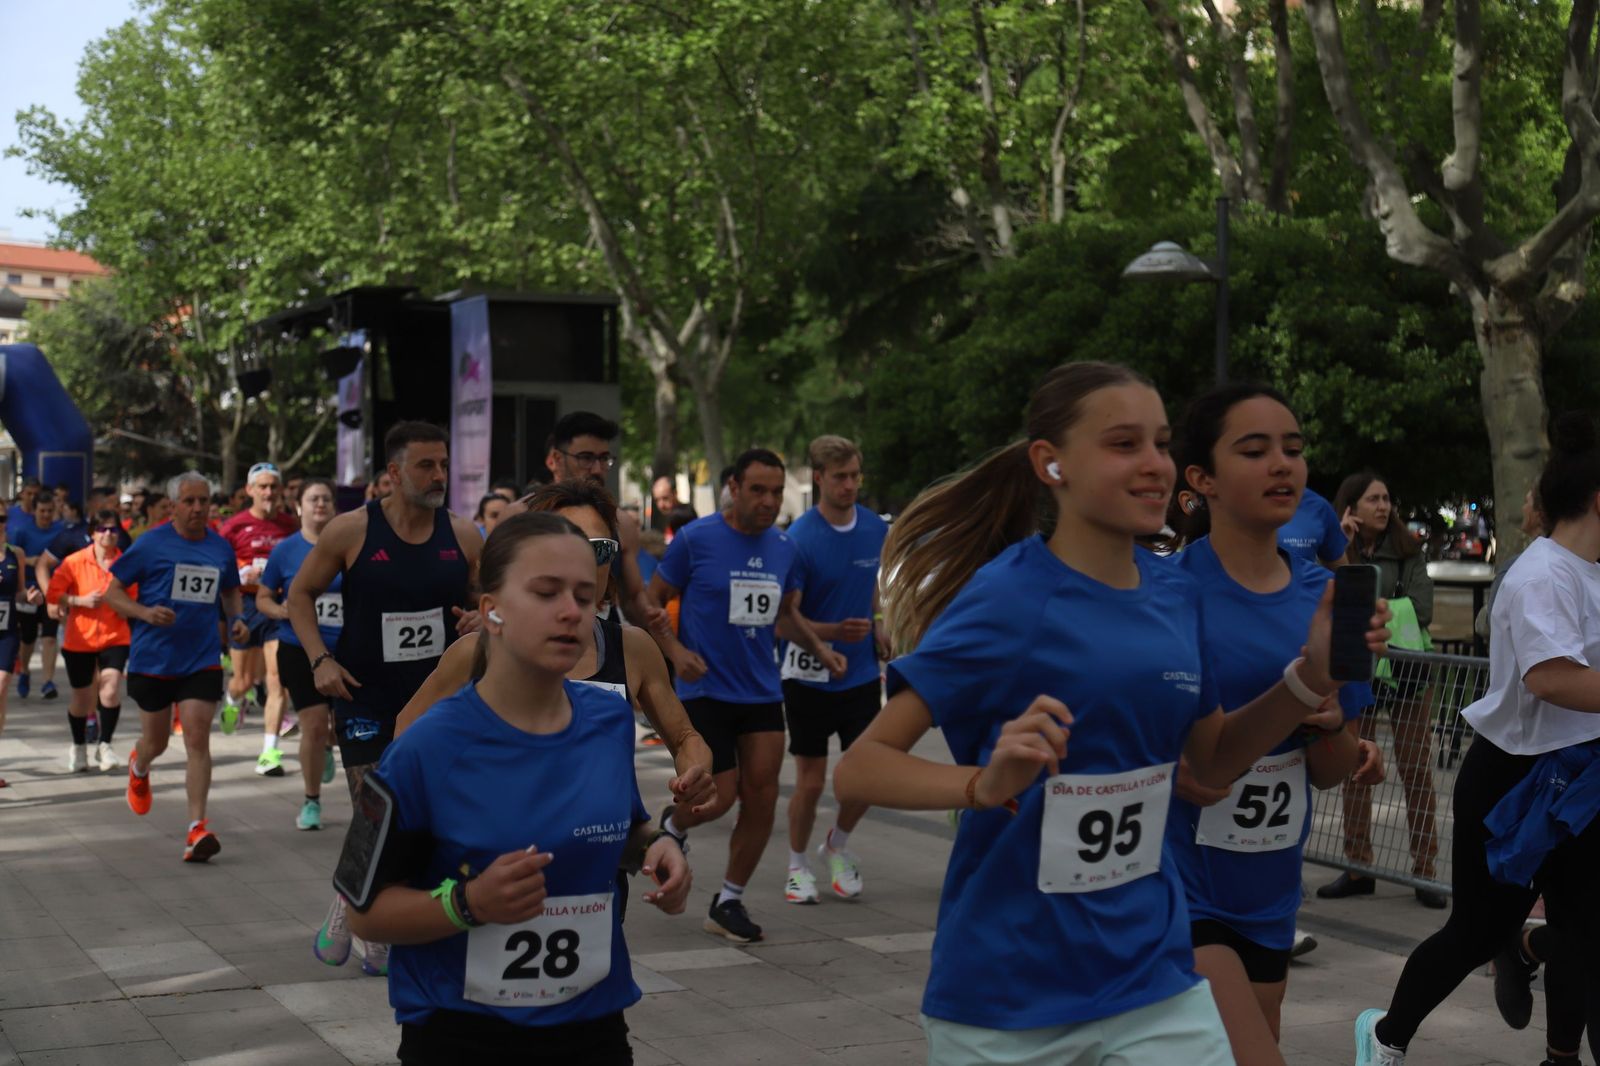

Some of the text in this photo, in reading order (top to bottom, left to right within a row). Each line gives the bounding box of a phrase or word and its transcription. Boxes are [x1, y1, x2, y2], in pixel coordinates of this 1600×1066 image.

[747, 556, 764, 569] 46
[179, 575, 214, 594] 137
[744, 593, 770, 614] 19
[399, 624, 433, 649] 22
[1052, 782, 1074, 796] DÍA
[1077, 786, 1092, 796] DE
[1095, 781, 1139, 796] CASTILLA
[1146, 772, 1168, 786] LEÓN
[1232, 781, 1291, 829] 52
[573, 823, 615, 837] CASTILLA
[616, 821, 623, 832] Y
[1078, 802, 1144, 864] 95
[571, 905, 578, 914] Y
[580, 902, 606, 914] LEÓN
[502, 929, 580, 980] 28
